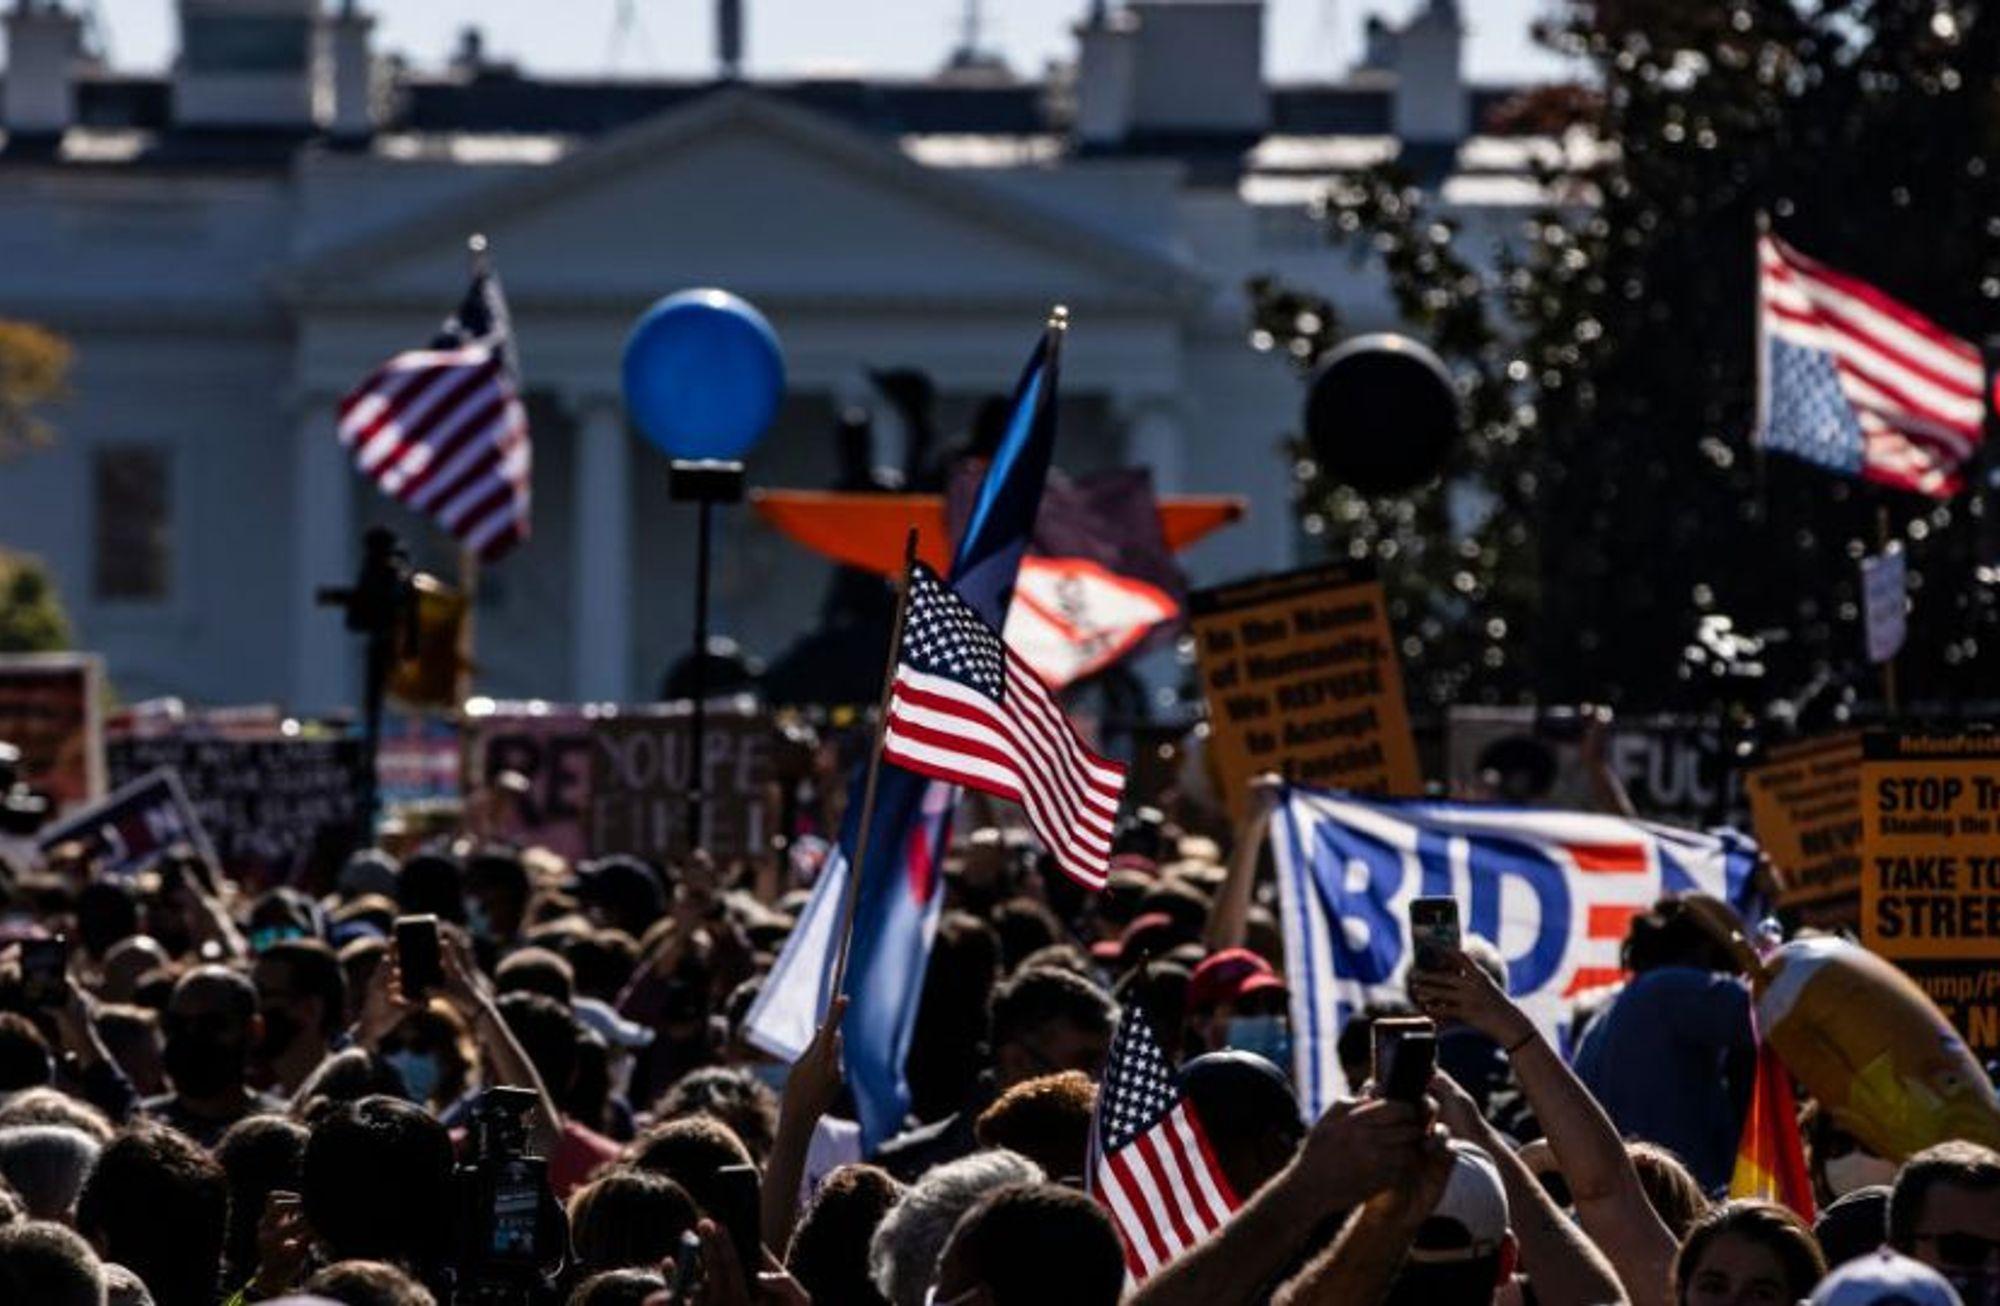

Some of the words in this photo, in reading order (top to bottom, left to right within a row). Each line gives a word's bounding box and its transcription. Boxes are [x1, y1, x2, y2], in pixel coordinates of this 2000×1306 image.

[1879, 776, 1963, 811] STOP
[1960, 814, 1990, 833] the
[1875, 857, 1957, 890] TAKE
[1967, 857, 2000, 890] TO
